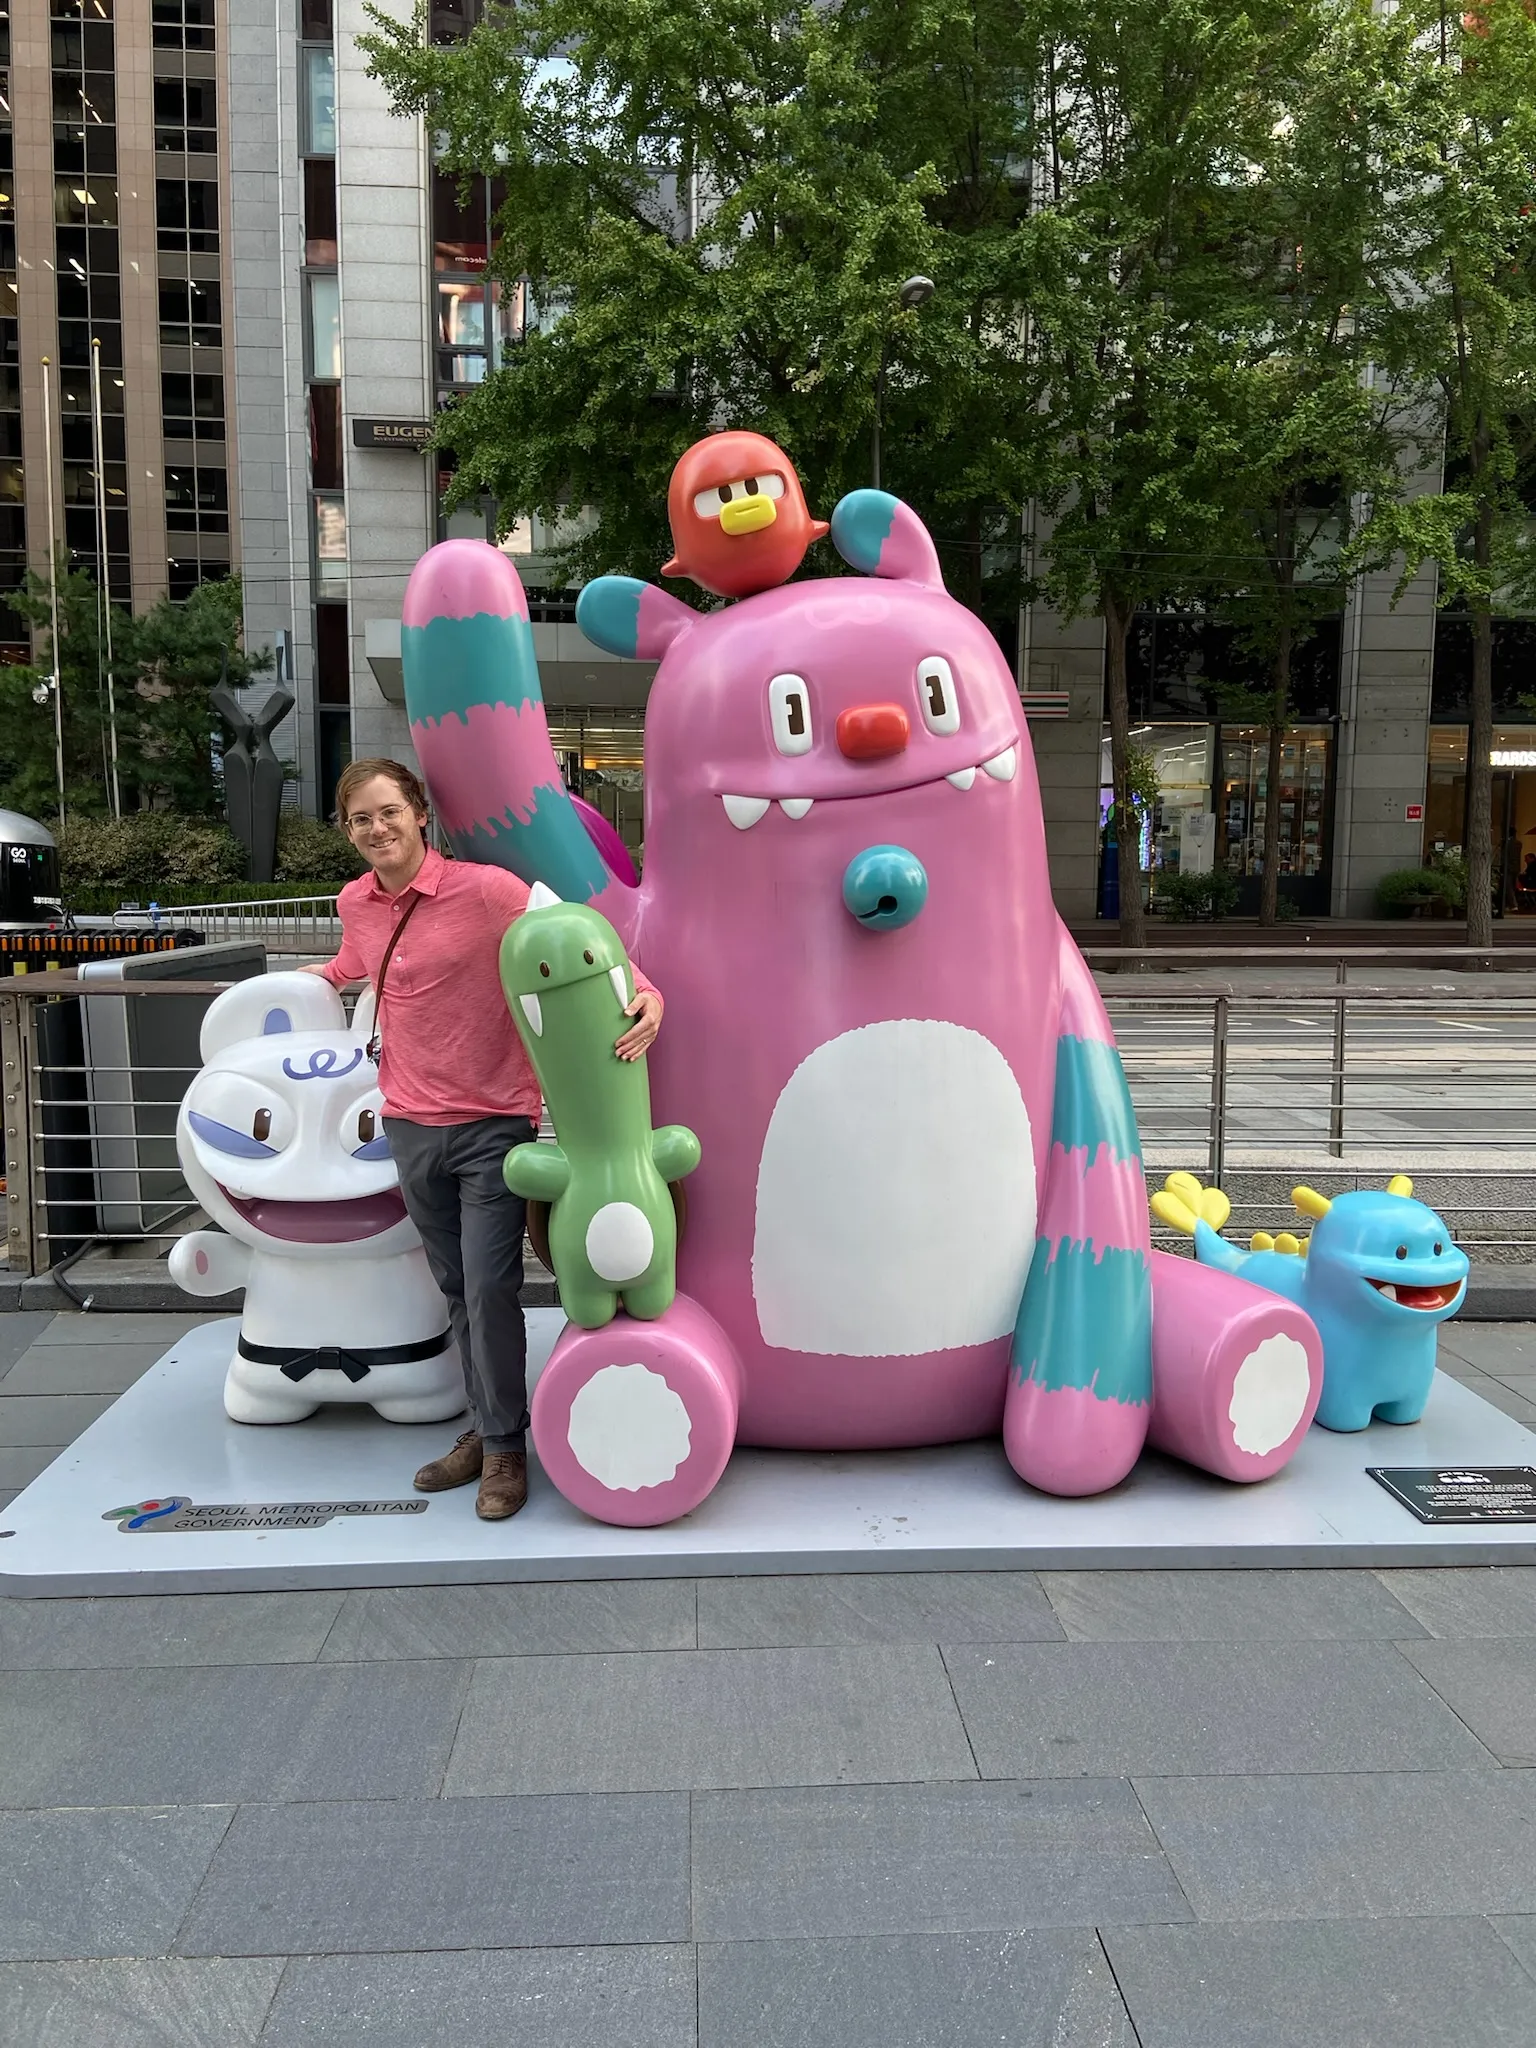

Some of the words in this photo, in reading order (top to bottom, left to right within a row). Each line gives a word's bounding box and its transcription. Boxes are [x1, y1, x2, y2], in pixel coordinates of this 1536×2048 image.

[373, 425, 435, 438] EUGEN
[182, 1507, 250, 1517] SEOUL
[258, 1502, 421, 1515] METROPOLITAN
[174, 1516, 325, 1529] GOVERNMENT
